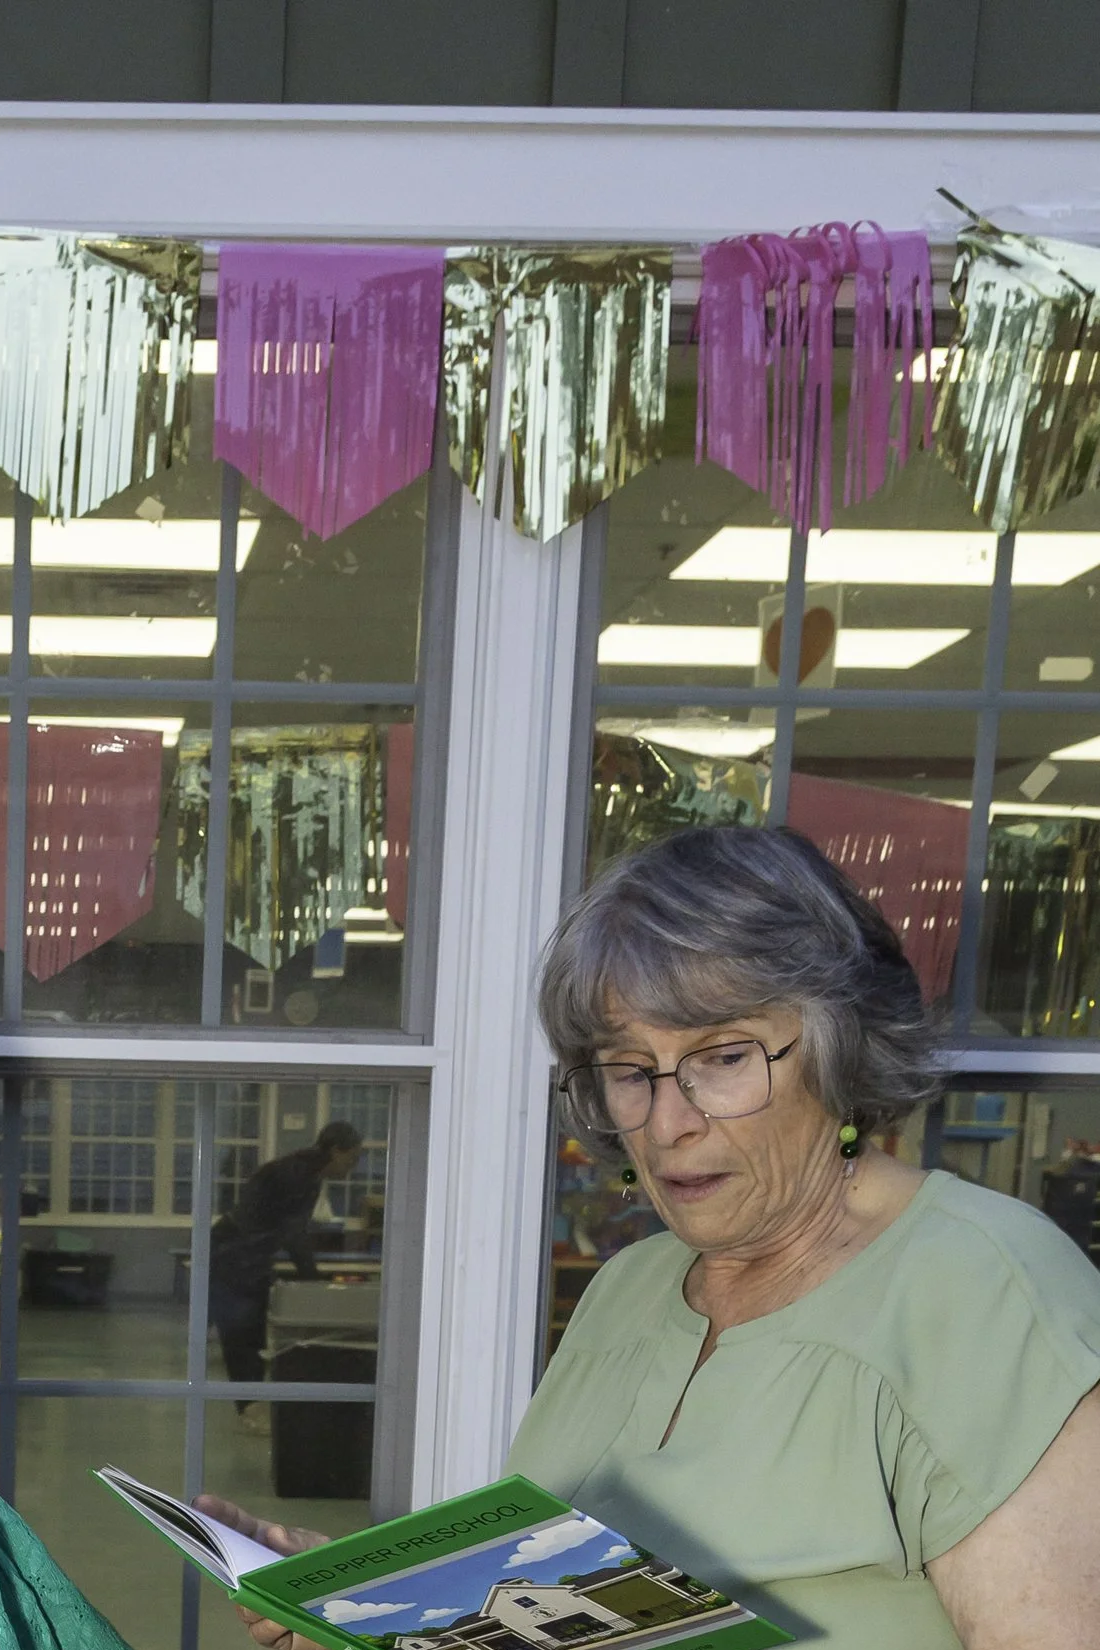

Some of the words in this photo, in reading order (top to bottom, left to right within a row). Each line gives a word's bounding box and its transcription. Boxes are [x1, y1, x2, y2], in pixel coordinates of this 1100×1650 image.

[286, 1569, 336, 1591] PIED
[334, 1547, 399, 1575] PIPER
[397, 1502, 534, 1556] PRESCHOOL
